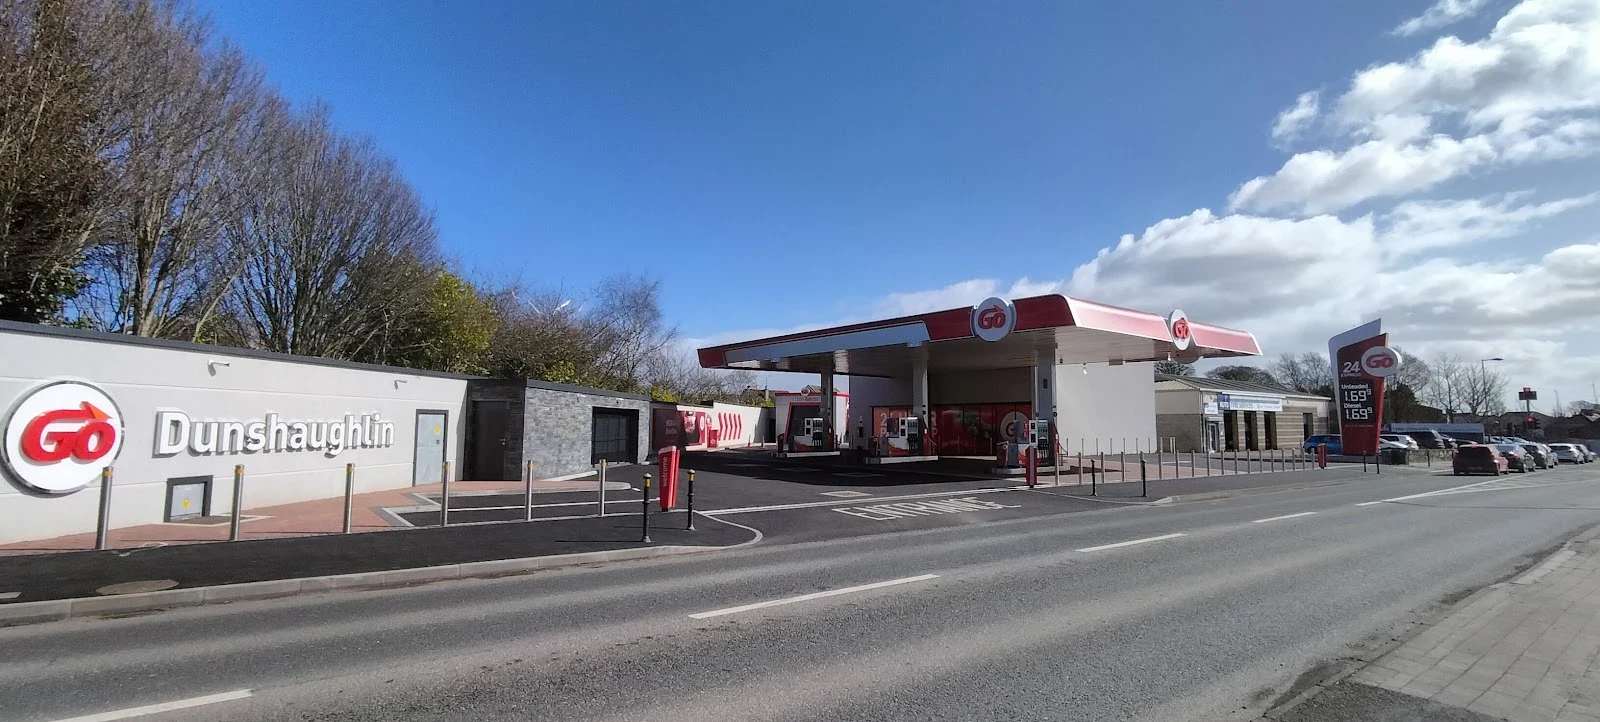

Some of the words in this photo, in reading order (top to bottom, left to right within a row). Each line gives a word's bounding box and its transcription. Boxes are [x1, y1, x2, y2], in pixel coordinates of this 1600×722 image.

[978, 304, 1006, 330] GO
[1343, 362, 1361, 372] 24
[1366, 352, 1394, 368] GO
[22, 400, 116, 463] GO
[153, 408, 396, 457] Dunshaughlin
[831, 496, 1022, 521] ENTRANCE
